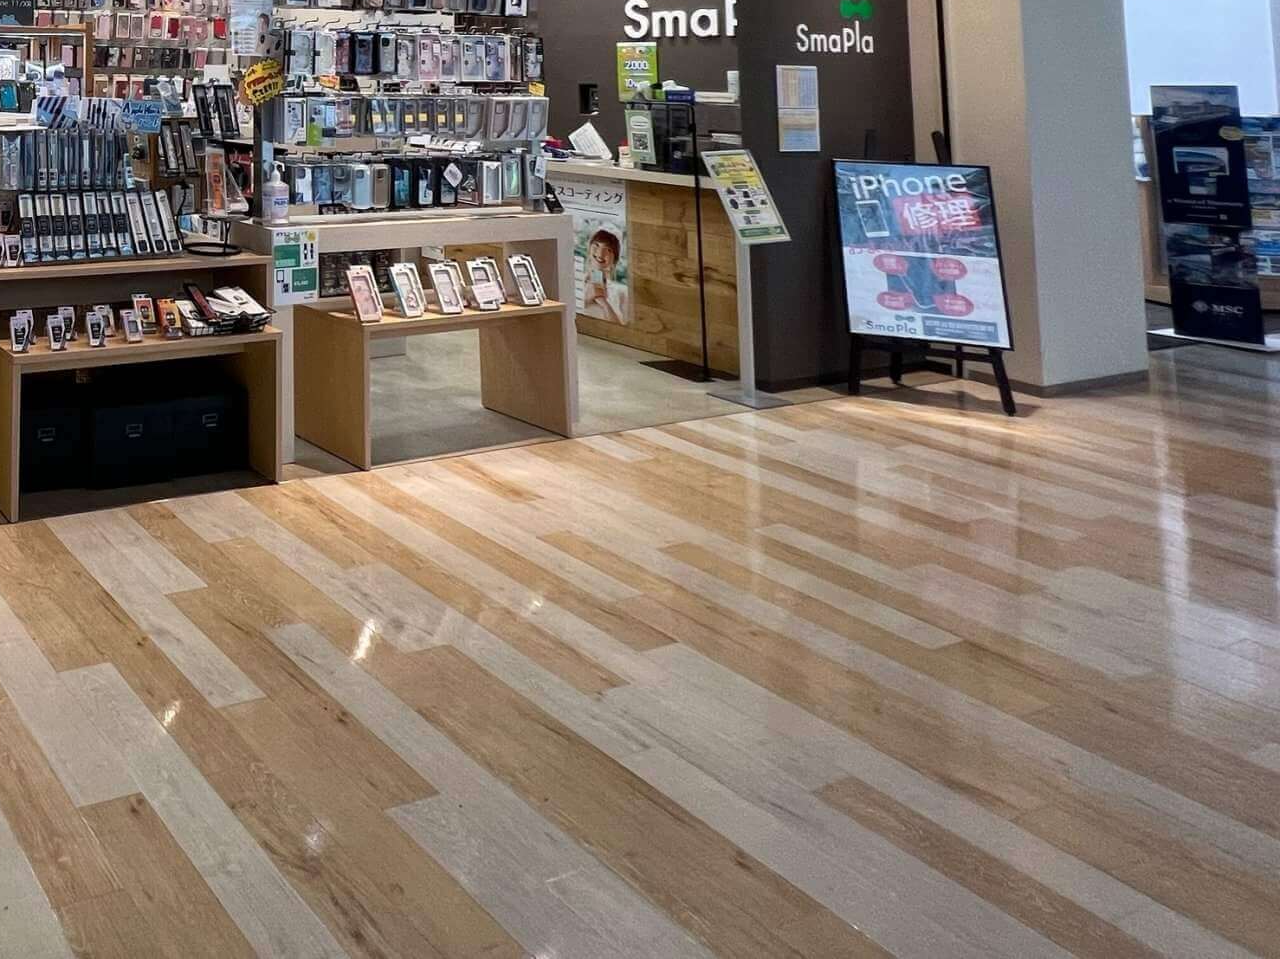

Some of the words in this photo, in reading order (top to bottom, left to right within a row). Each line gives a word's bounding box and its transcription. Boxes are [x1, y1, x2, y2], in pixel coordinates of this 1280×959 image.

[796, 20, 874, 53] SmaPla
[849, 173, 968, 200] iPhone
[903, 199, 979, 230] 修理
[1211, 303, 1244, 315] MSC
[866, 319, 918, 335] SmaPla
